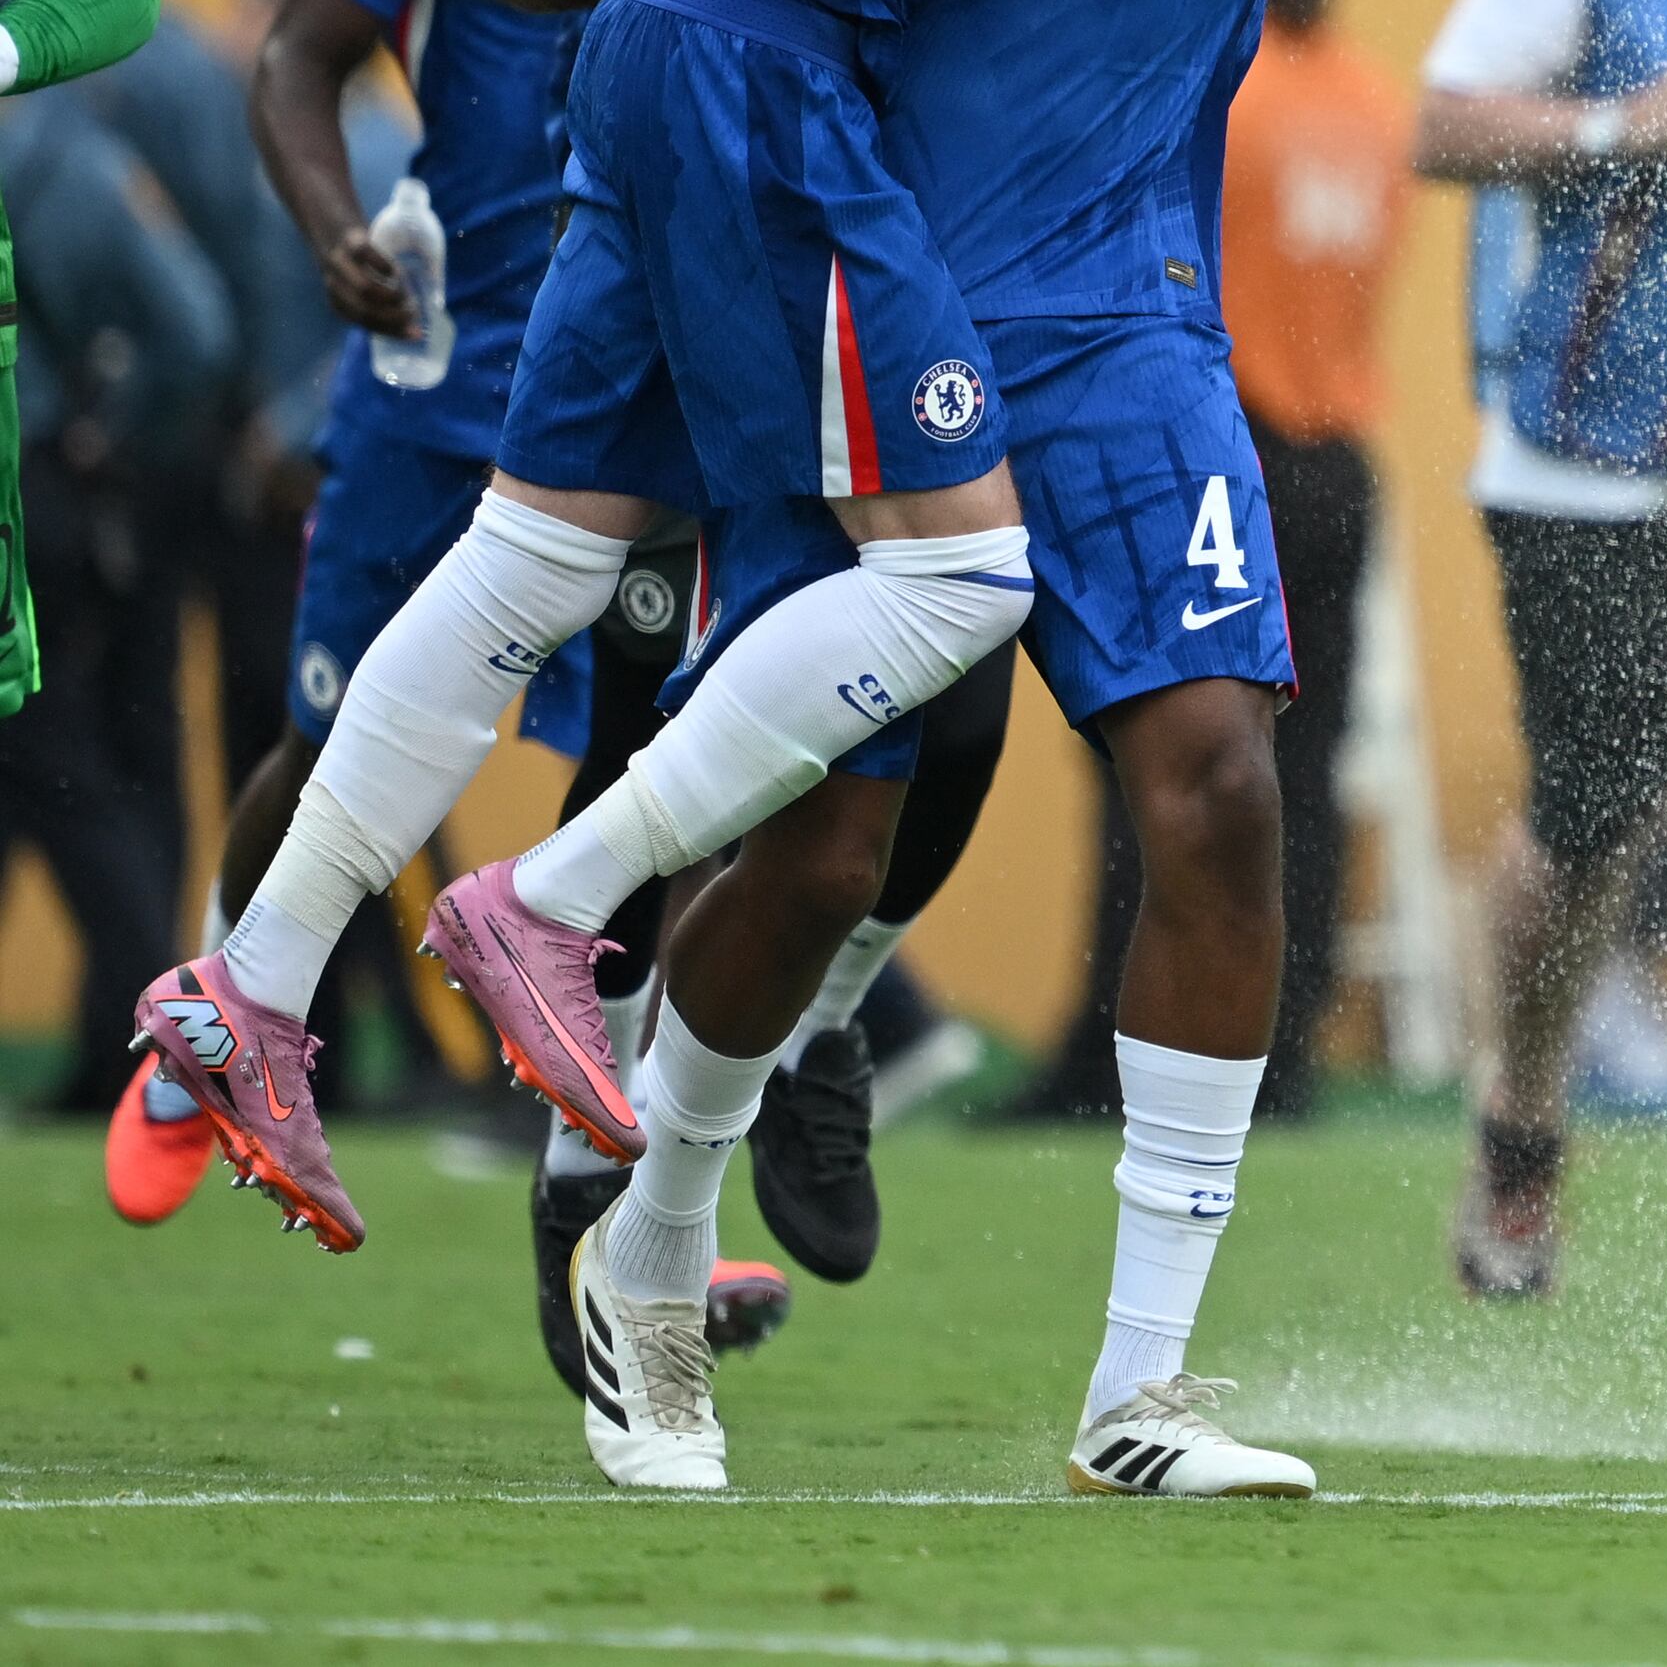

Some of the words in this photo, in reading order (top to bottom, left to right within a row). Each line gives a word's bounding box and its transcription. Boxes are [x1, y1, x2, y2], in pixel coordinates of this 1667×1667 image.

[922, 362, 967, 387] CHELSEA
[1187, 475, 1249, 589] 4
[858, 674, 900, 720] CFC
